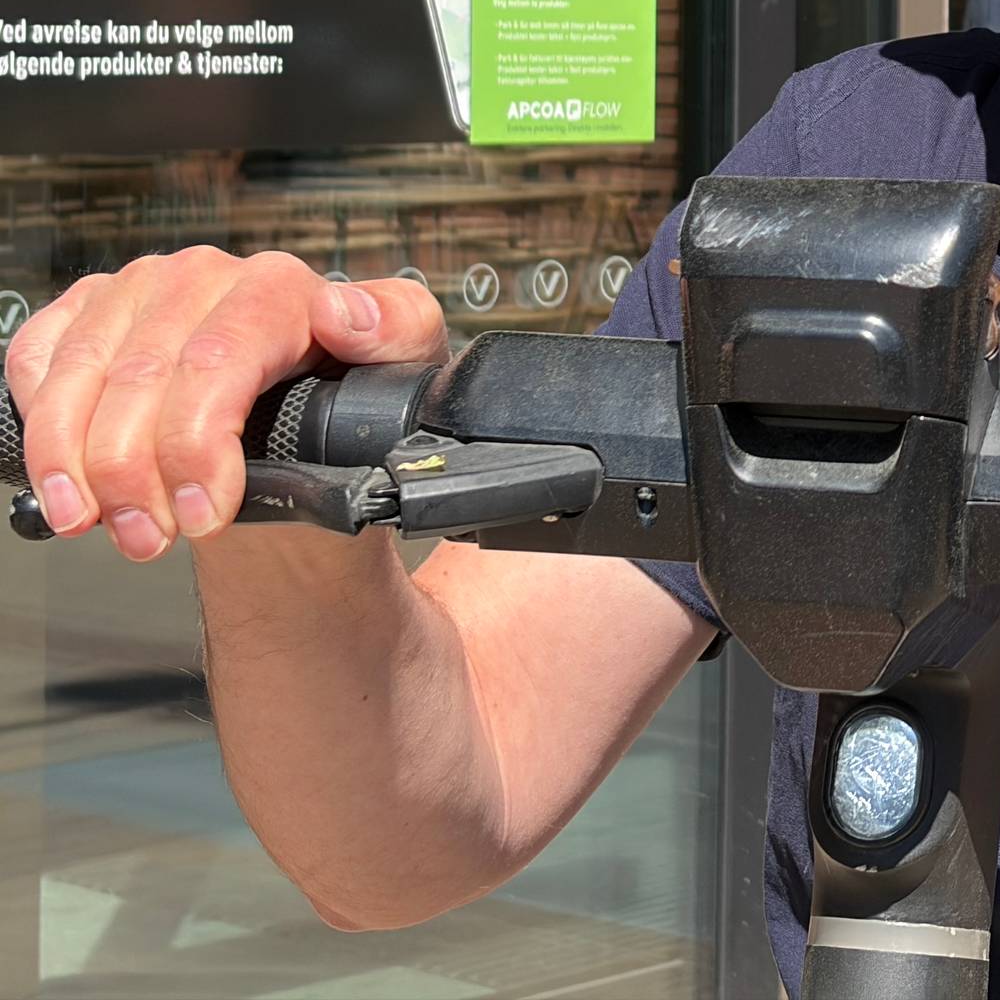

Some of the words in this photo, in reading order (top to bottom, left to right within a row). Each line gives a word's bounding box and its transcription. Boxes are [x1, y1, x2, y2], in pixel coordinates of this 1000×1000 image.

[31, 18, 102, 44] avreise
[107, 20, 141, 44] kan
[146, 20, 169, 44] du
[174, 19, 224, 48] velge
[228, 20, 294, 44] mellom
[79, 51, 173, 80] produkter
[177, 51, 192, 75] &
[197, 51, 283, 79] tjenester:
[507, 101, 565, 120] APCOA
[583, 102, 622, 119] FLOW
